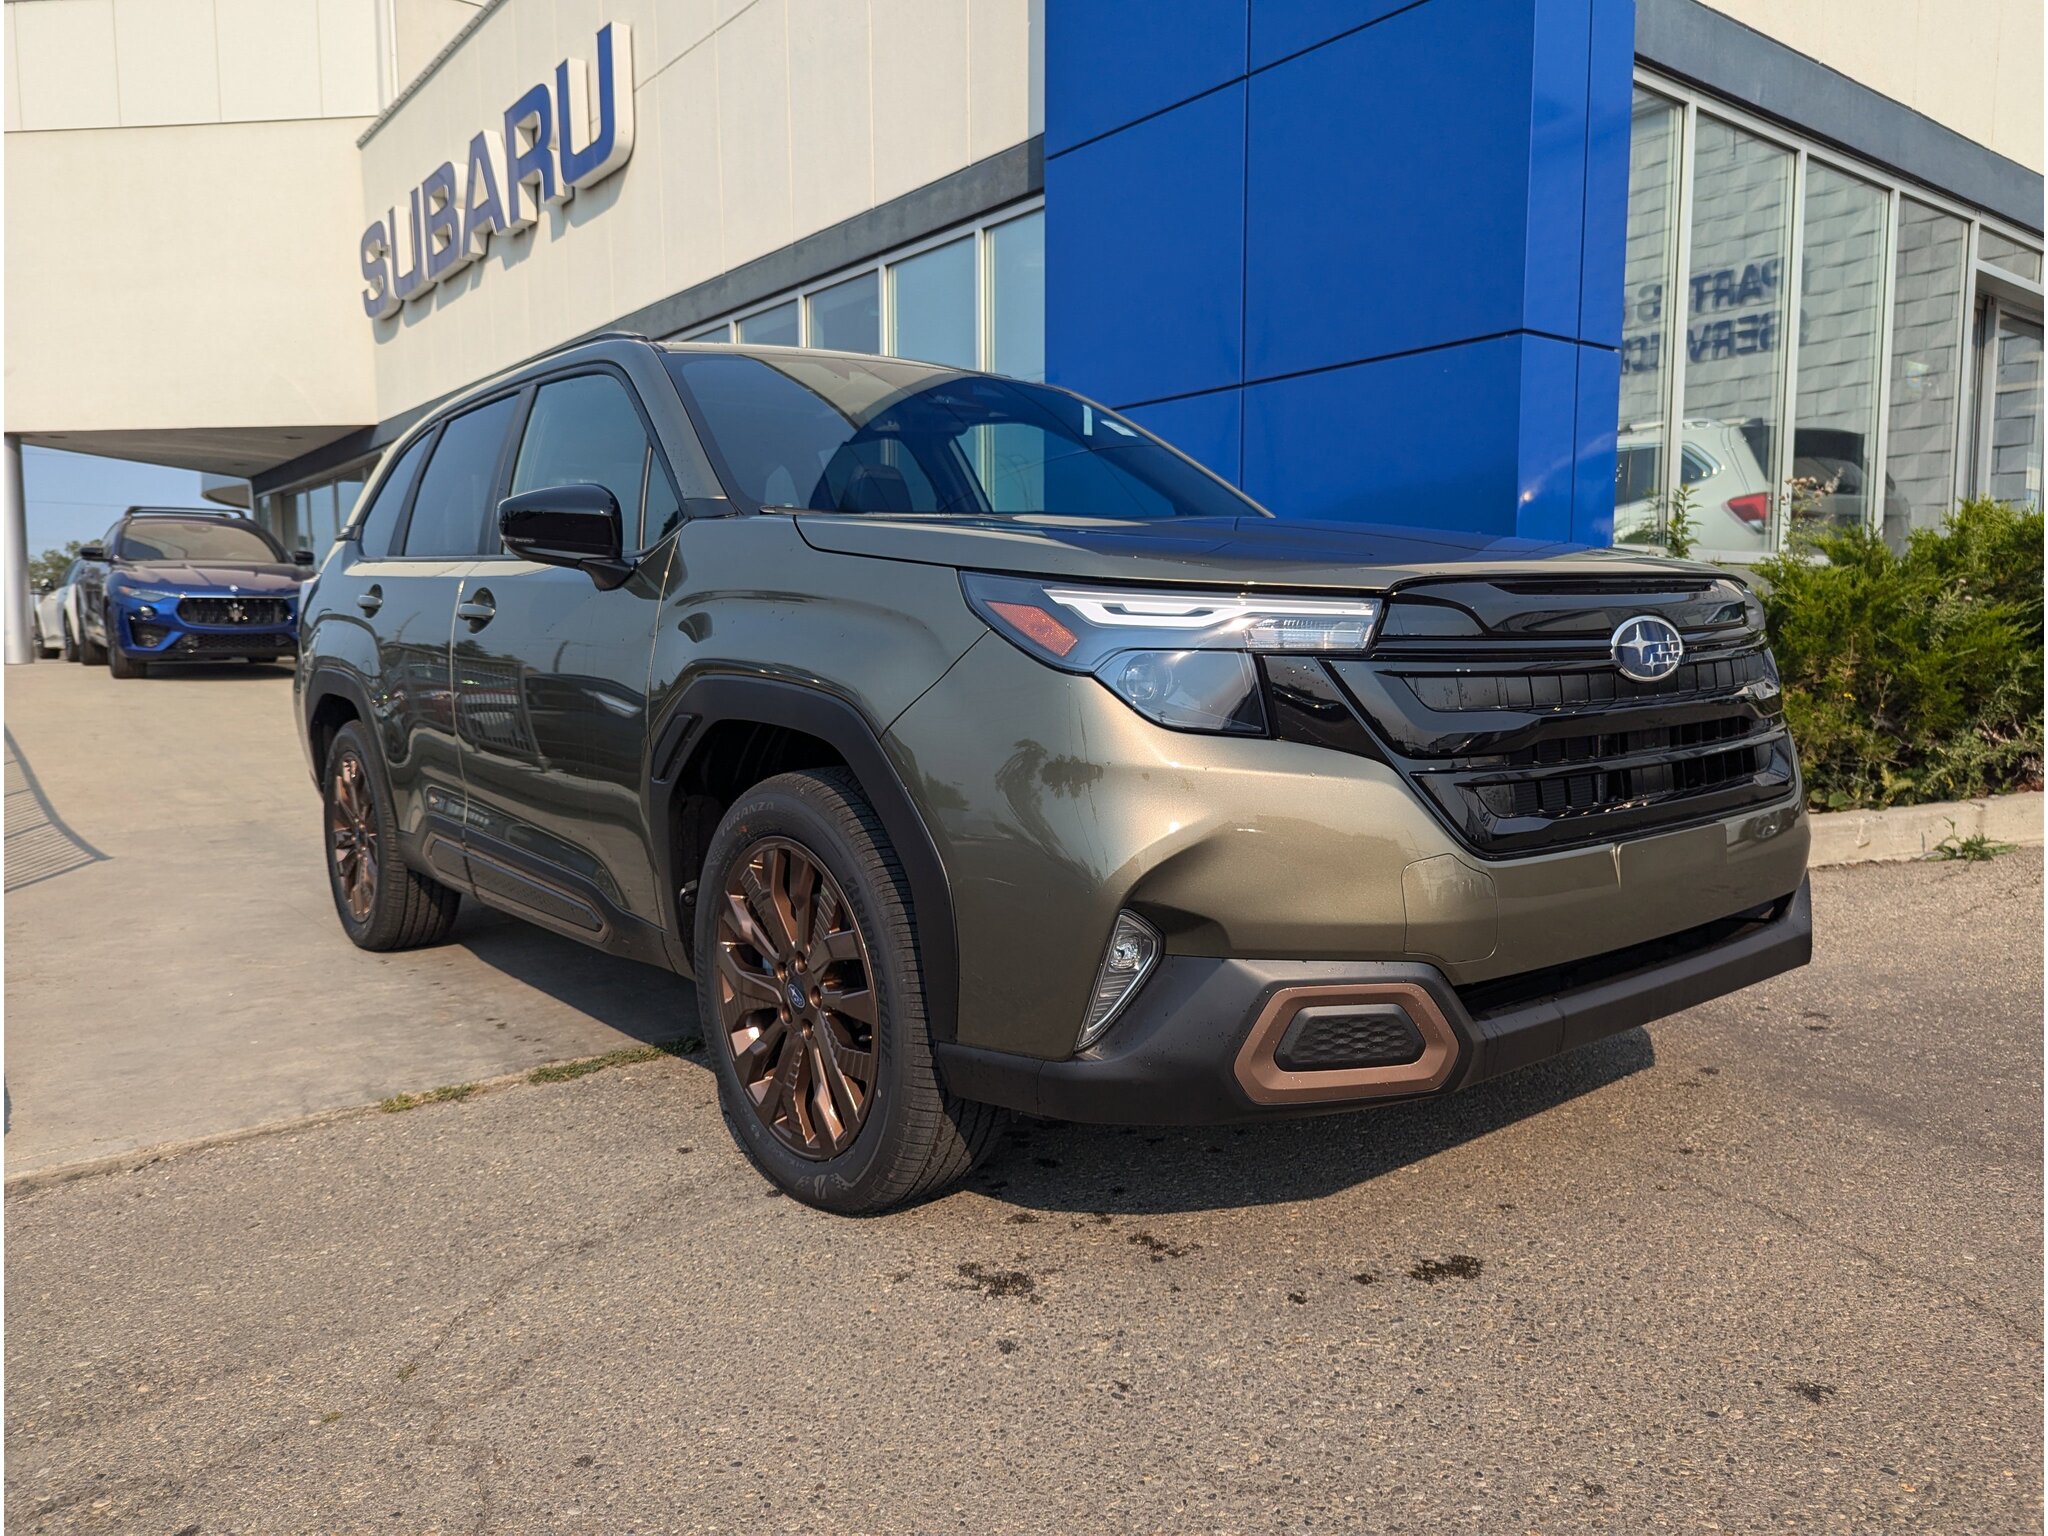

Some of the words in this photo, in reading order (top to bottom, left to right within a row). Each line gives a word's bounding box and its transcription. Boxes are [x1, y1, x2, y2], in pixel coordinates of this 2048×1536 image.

[360, 22, 632, 321] SUBARU
[721, 800, 775, 837] TURANZA
[845, 877, 894, 1068] BRIDGESTONE
